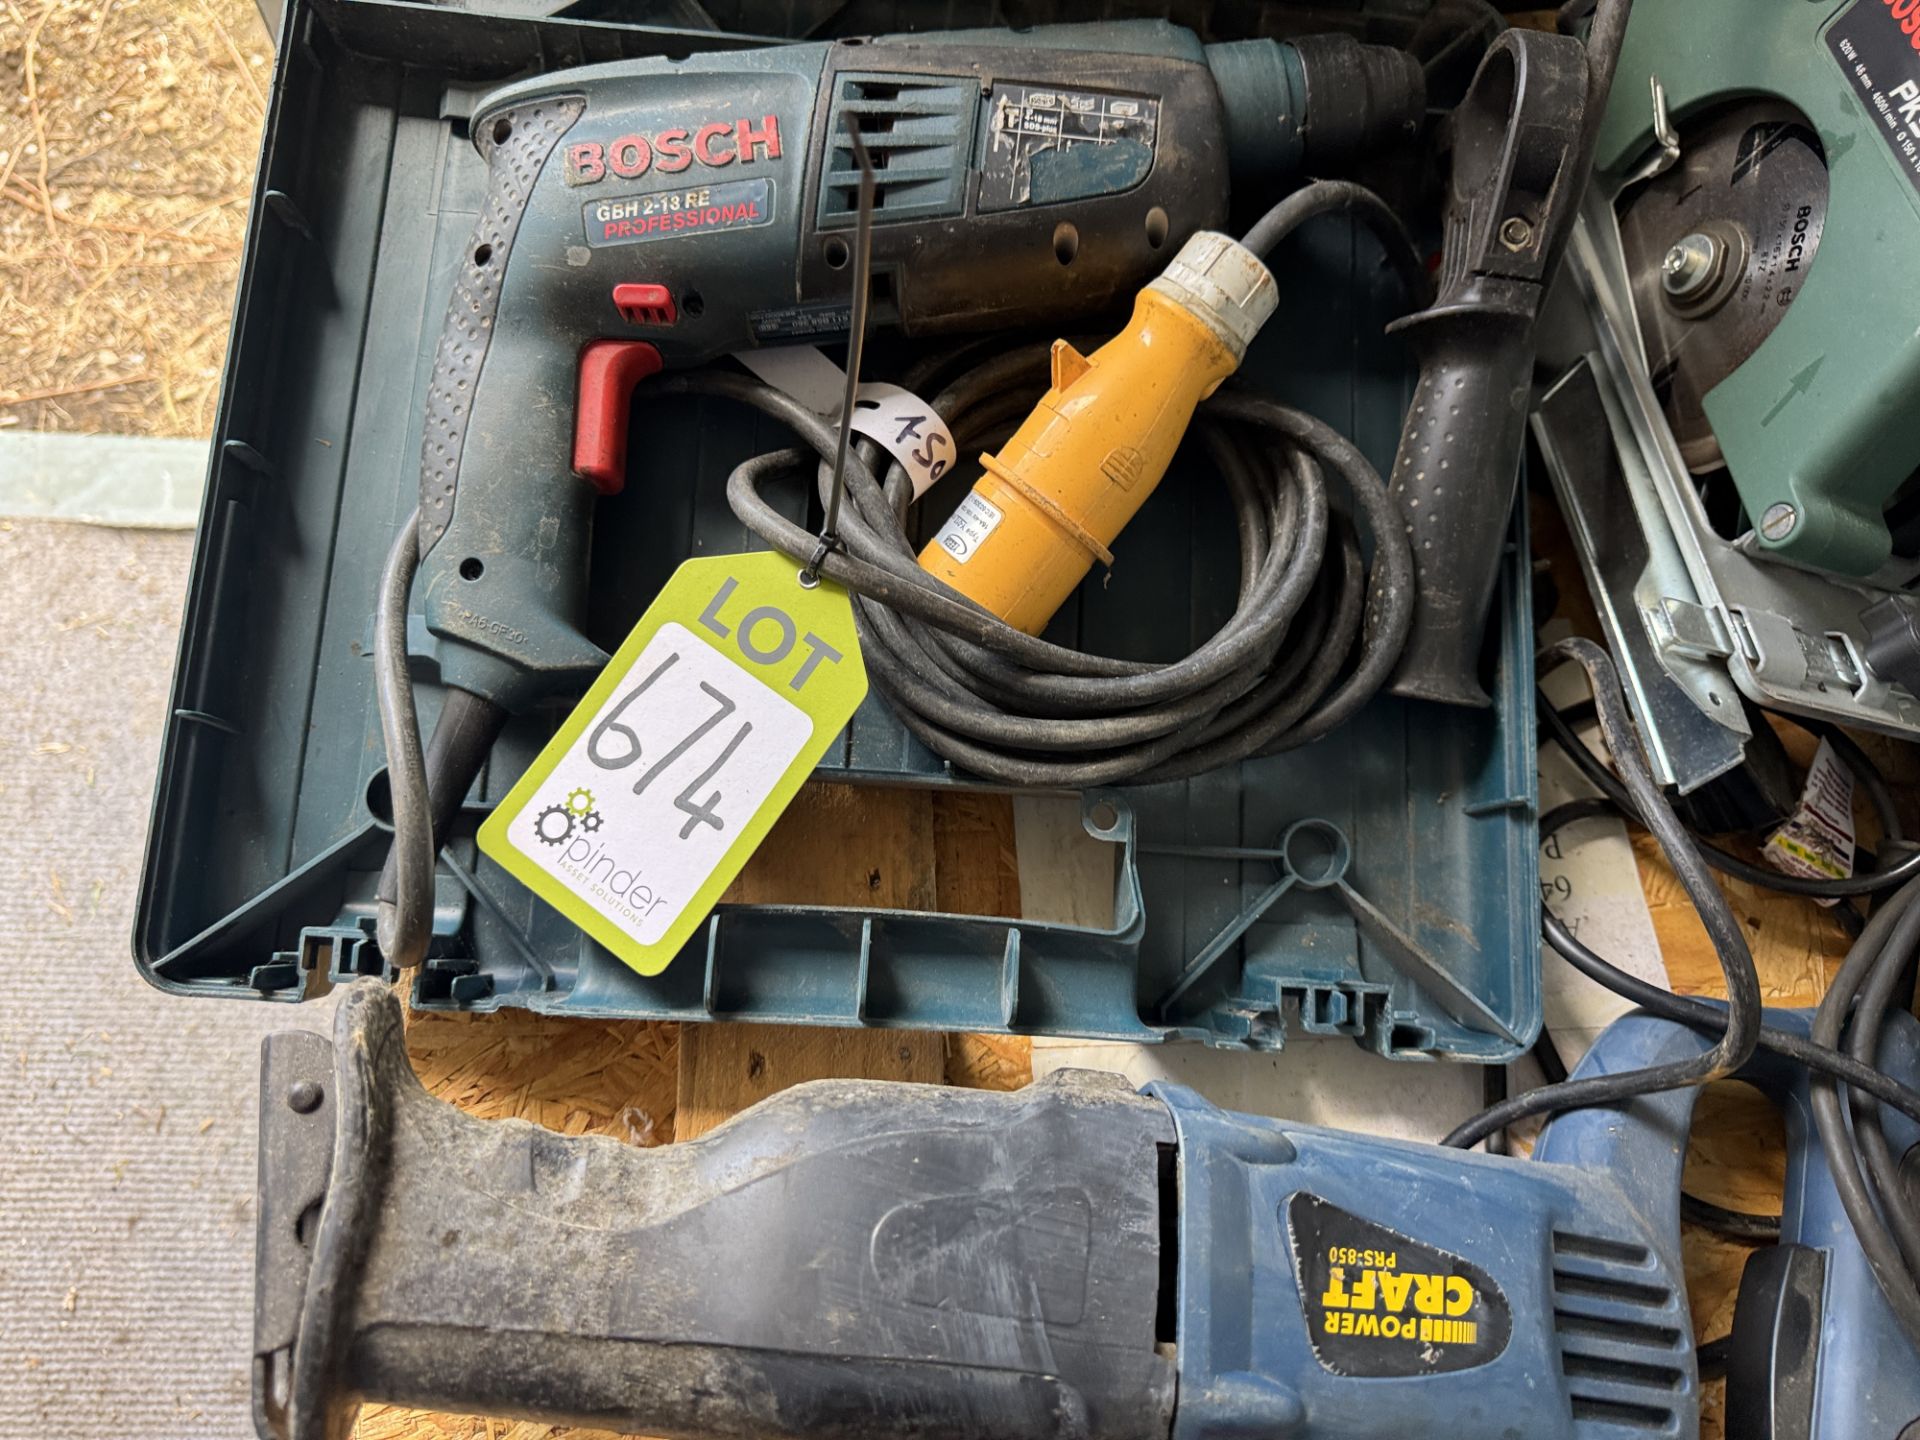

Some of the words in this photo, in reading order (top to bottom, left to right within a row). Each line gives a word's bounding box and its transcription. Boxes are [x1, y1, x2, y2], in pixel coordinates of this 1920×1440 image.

[1839, 38, 1858, 61] 620W
[564, 114, 783, 187] BOSCH
[596, 200, 638, 222] GBH
[684, 190, 711, 210] RE
[604, 201, 760, 240] PROFESSIONAL
[1784, 204, 1812, 273] BOSCH
[697, 576, 844, 692] LOT
[587, 652, 754, 840] 674
[557, 835, 668, 917] pinder
[559, 860, 591, 885] ASSET
[590, 883, 645, 928] SOLUTIONS
[1329, 1246, 1396, 1269] PRS-850
[1322, 1267, 1475, 1317] CRAFT
[1324, 1311, 1417, 1340] POWER
